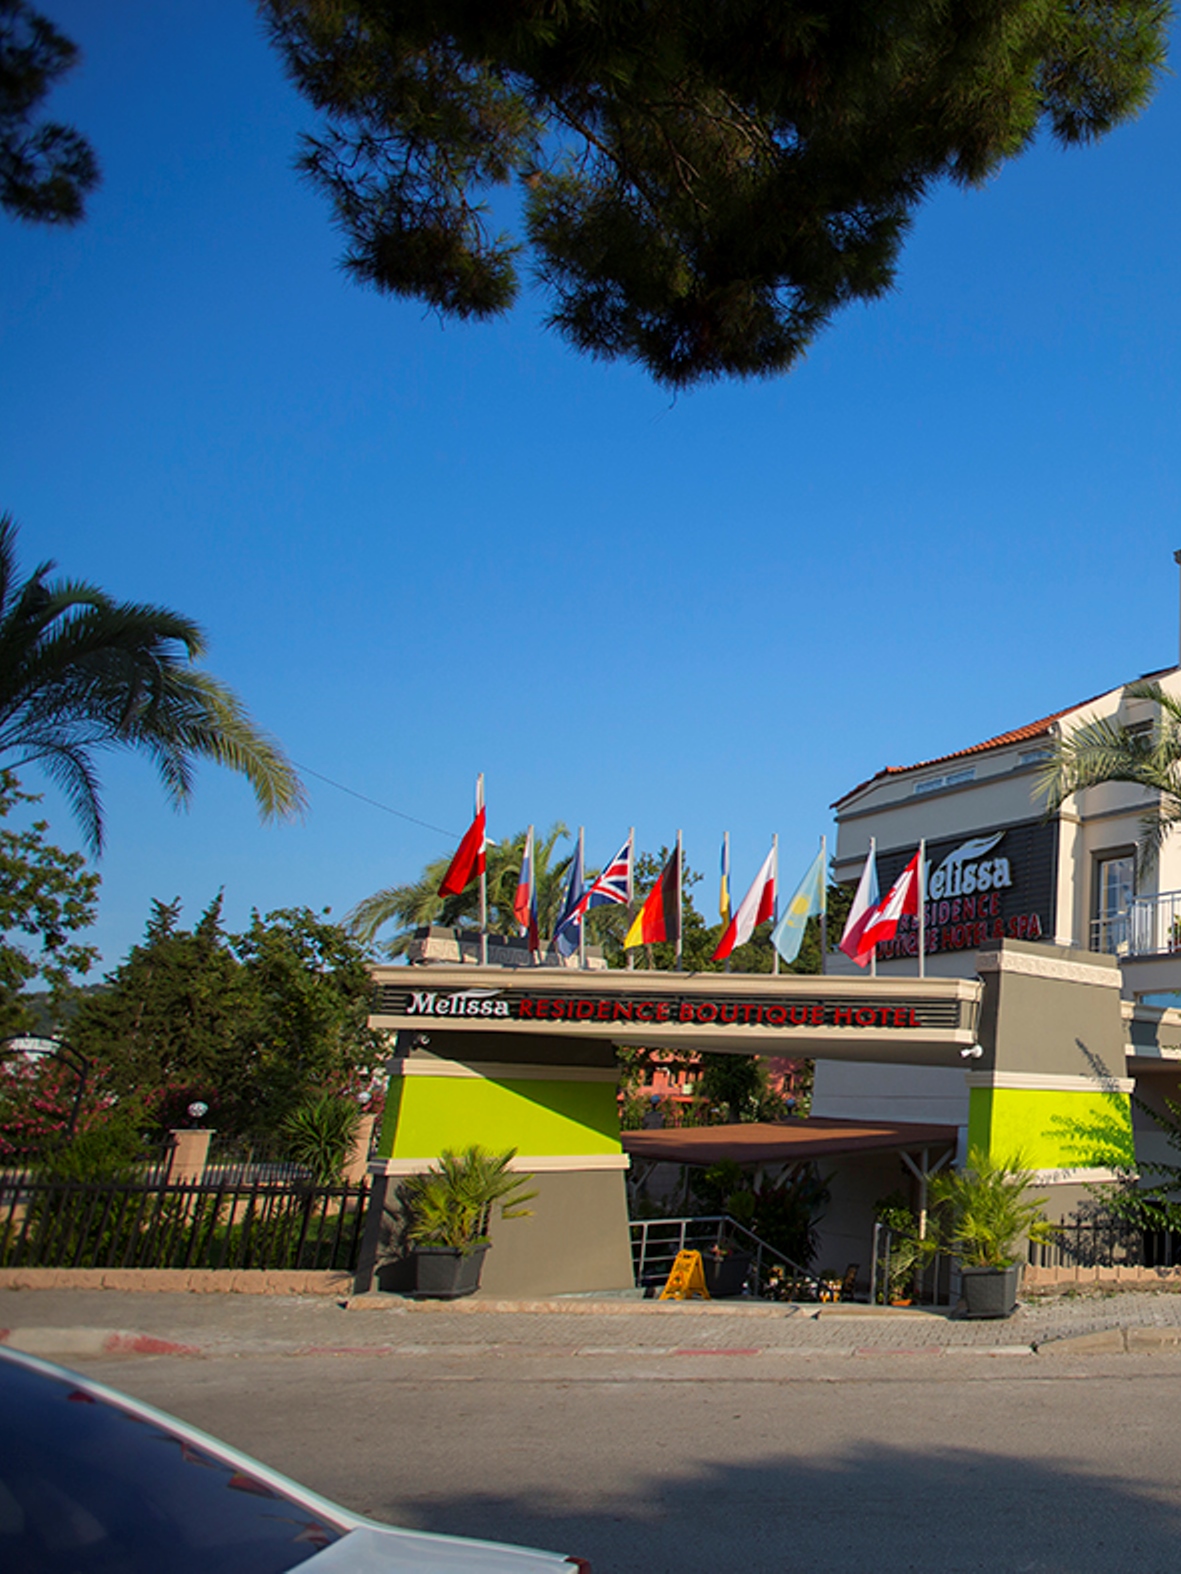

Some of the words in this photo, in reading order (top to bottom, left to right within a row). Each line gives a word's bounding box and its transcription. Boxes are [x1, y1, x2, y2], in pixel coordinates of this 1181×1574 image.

[941, 920, 988, 950] HOTEL
[991, 918, 1005, 940] &
[1008, 913, 1042, 940] SPA
[407, 991, 510, 1016] Melissa
[518, 999, 670, 1021] RESIDENCE
[679, 1003, 825, 1025] BOUTIQUE
[834, 1007, 922, 1027] HOTEL
